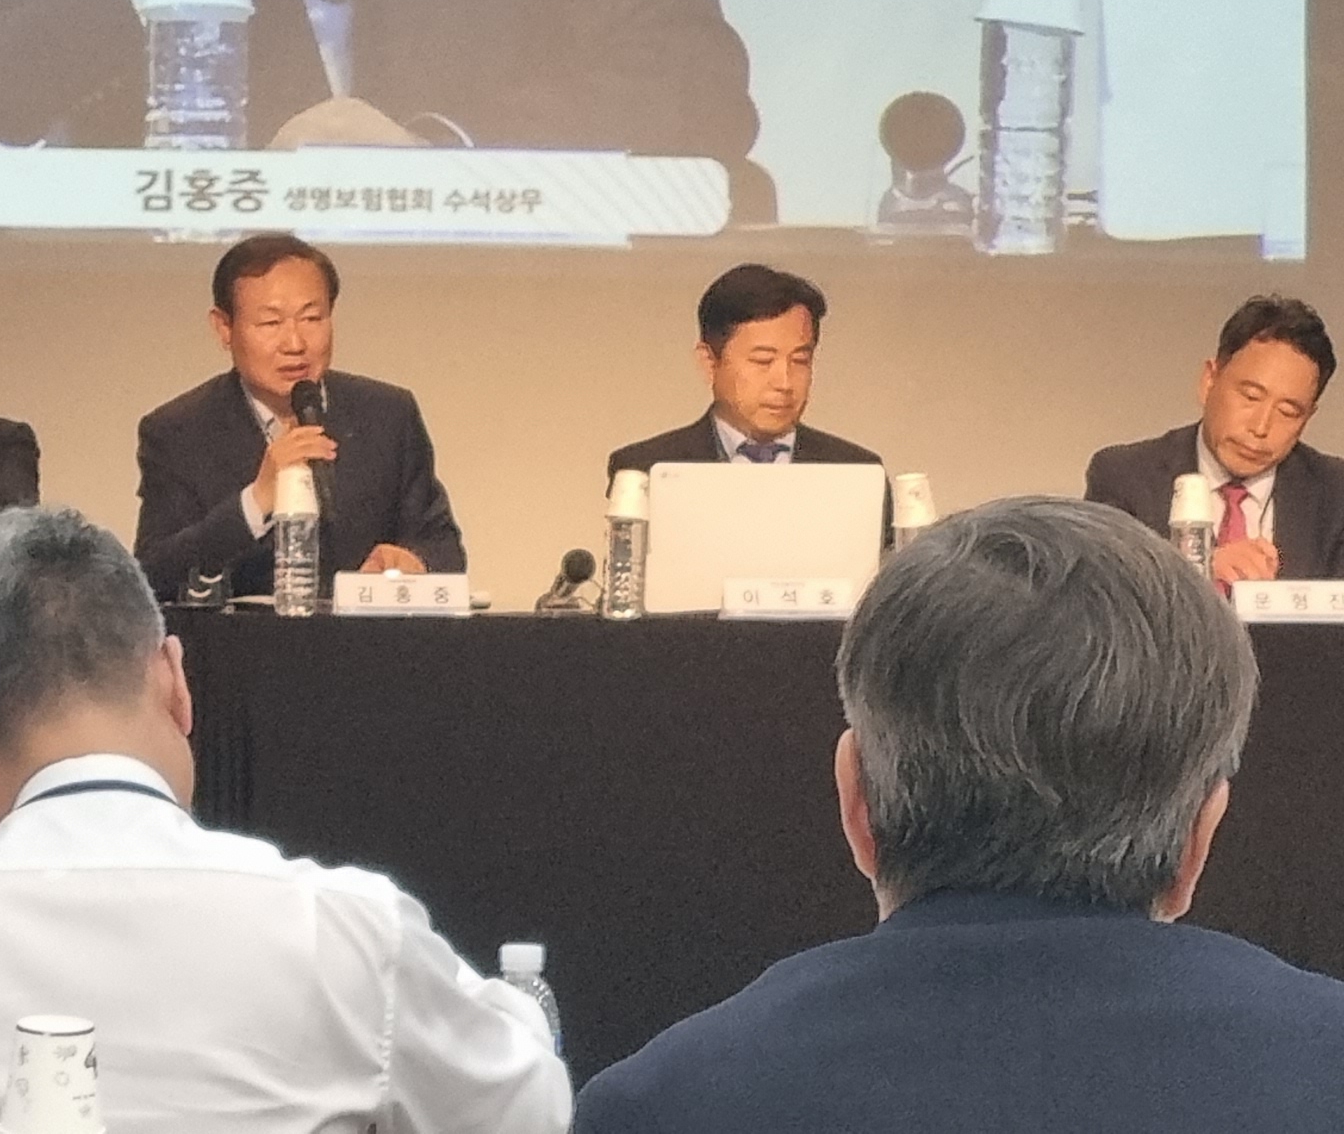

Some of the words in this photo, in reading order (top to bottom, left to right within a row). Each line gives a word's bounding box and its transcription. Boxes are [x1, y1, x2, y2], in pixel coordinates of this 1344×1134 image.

[135, 168, 269, 214] 김홍중
[283, 186, 434, 214] 생명보험협회
[443, 187, 544, 215] 수석상무
